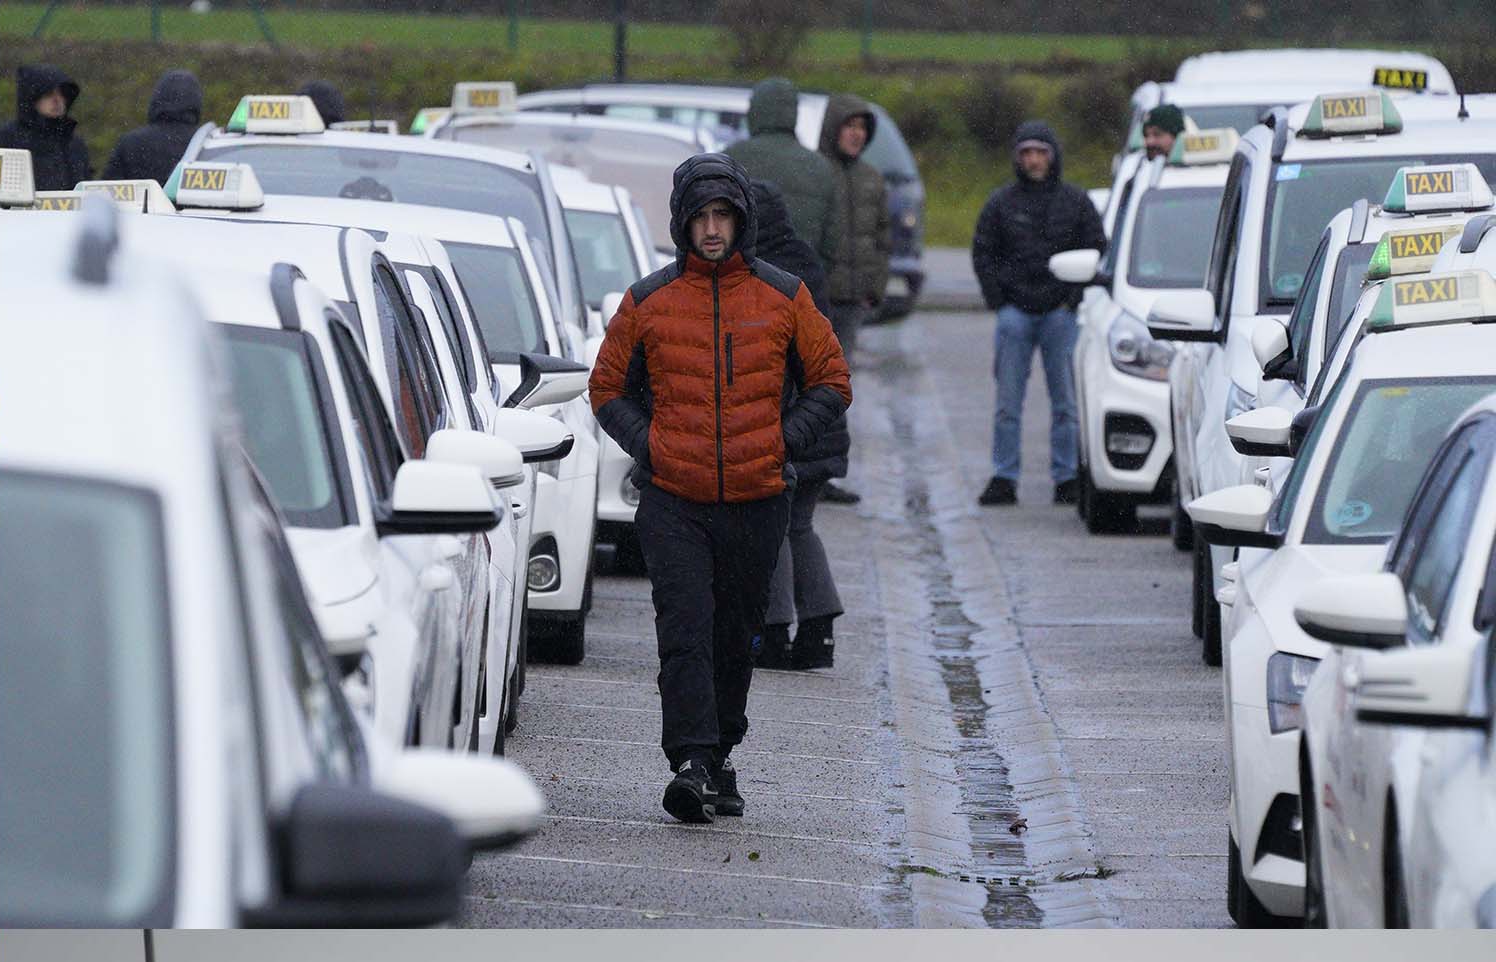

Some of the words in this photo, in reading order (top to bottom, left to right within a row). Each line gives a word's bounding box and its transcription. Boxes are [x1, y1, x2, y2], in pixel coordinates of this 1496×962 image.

[1377, 69, 1425, 87] TAXI
[250, 102, 289, 119] TAXI
[1325, 98, 1365, 118] TAXI
[185, 170, 224, 190] TAXI
[1408, 171, 1453, 193] TAXI
[1392, 234, 1441, 256] TAXI
[1398, 278, 1456, 304] TAXI
